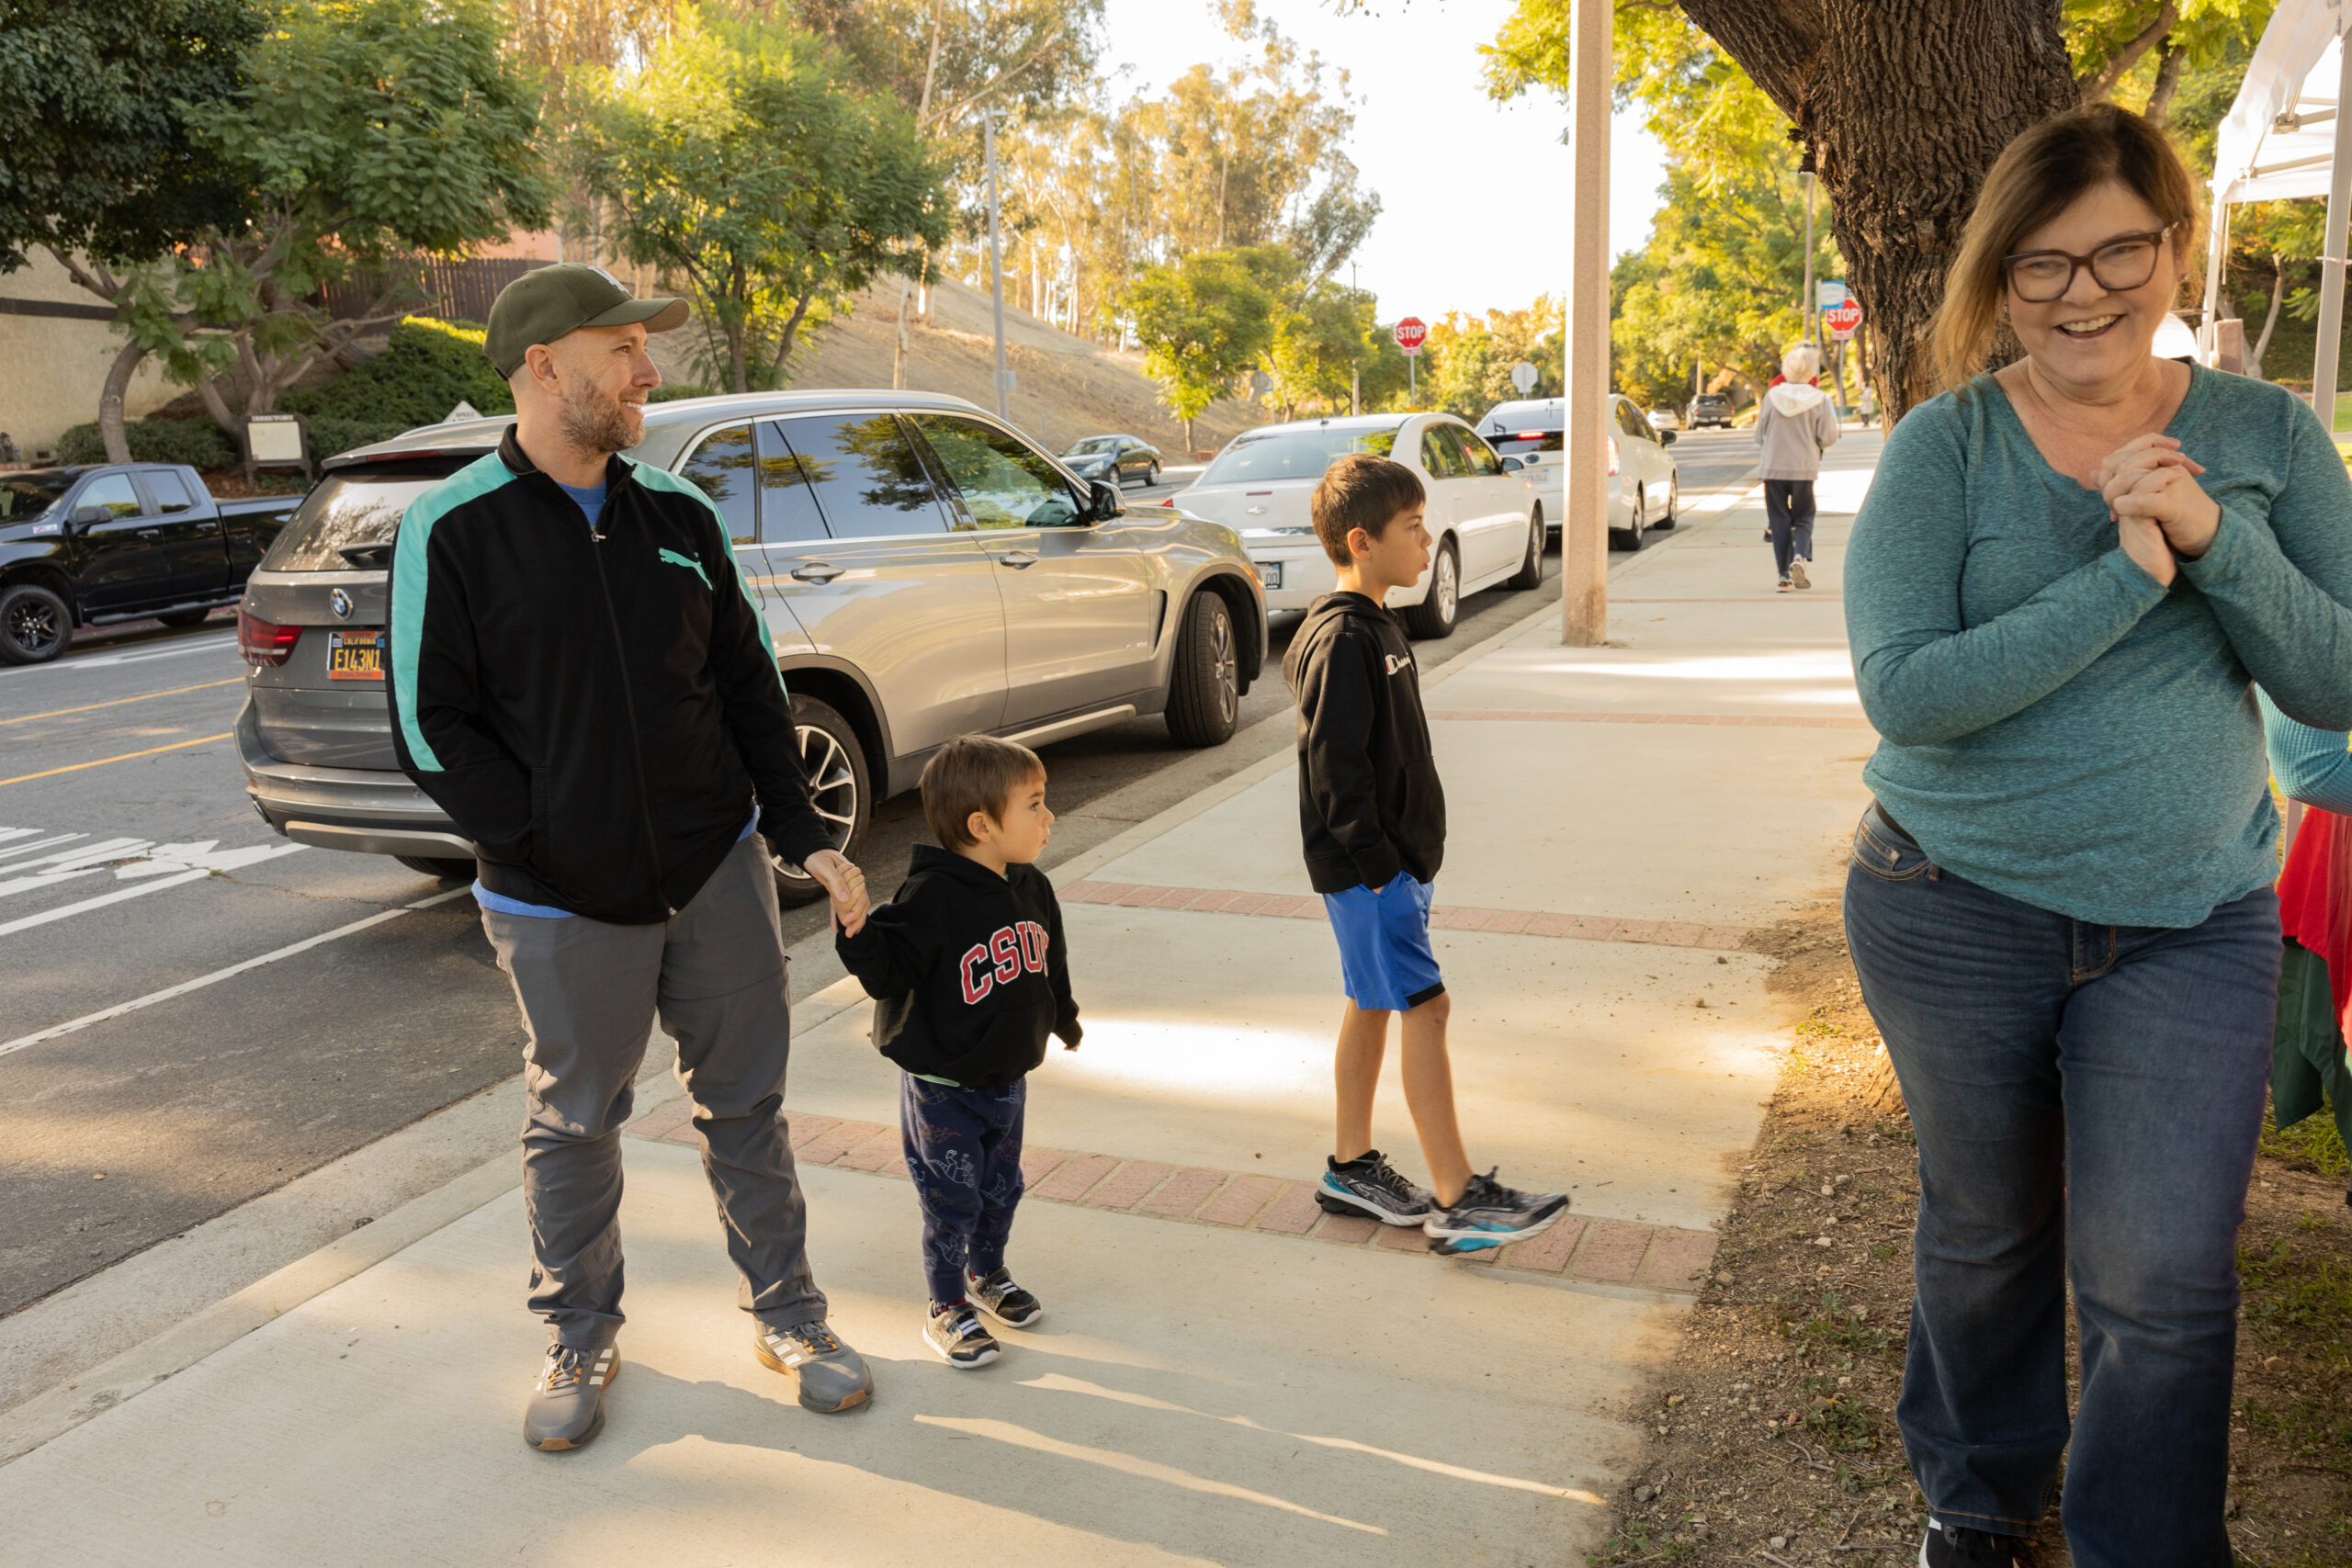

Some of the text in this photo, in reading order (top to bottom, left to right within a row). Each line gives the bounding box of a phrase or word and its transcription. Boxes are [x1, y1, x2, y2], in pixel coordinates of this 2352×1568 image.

[1828, 308, 1860, 323] STOP
[1397, 324, 1425, 340] STOP
[343, 637, 377, 646] CALIFORNIA
[334, 649, 381, 671] E143N1
